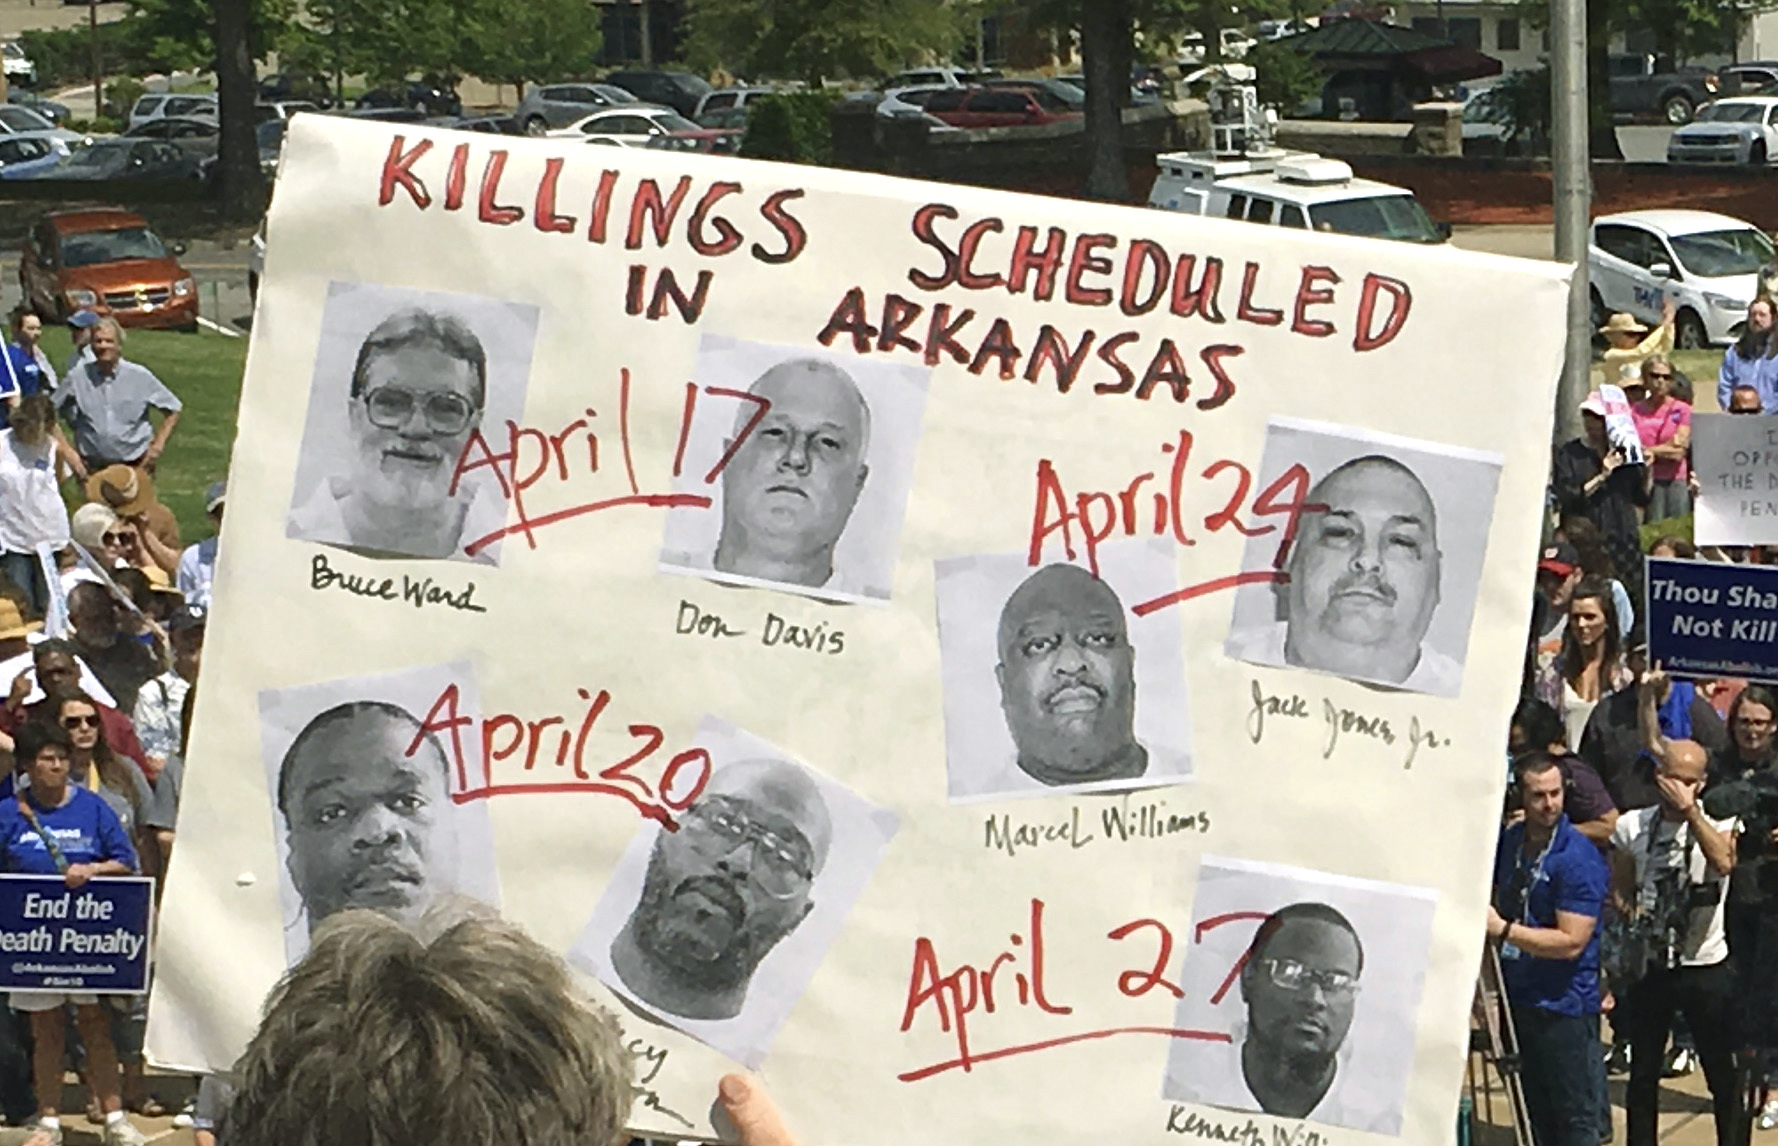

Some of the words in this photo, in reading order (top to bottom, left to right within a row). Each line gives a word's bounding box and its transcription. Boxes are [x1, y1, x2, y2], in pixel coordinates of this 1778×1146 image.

[379, 135, 807, 265] KILLINGS
[909, 203, 1413, 352] SCHEDULED
[624, 264, 714, 324] IN
[817, 287, 1245, 410] ARKANSAS
[449, 368, 639, 550] April
[672, 382, 772, 485] 17
[1766, 429, 1778, 446] I
[1027, 430, 1197, 581] April
[1199, 461, 1331, 570] 24
[1717, 472, 1754, 490] THE
[310, 552, 398, 600] Bruce
[403, 575, 487, 613] Ward
[1651, 579, 1720, 604] Thou
[676, 600, 747, 637] Don
[761, 612, 846, 655] Davis
[1671, 615, 1724, 638] Not
[1730, 618, 1778, 643] Kill
[404, 684, 610, 794] April
[600, 724, 713, 811] 20
[1247, 679, 1309, 744] Jack
[1323, 697, 1396, 759] Jones
[1102, 801, 1211, 842] Williams
[23, 892, 70, 919] End
[75, 893, 114, 920] the
[0, 925, 53, 952] eath
[59, 927, 145, 961] Penalty
[900, 898, 1072, 1073] April
[1109, 911, 1285, 1005] 27
